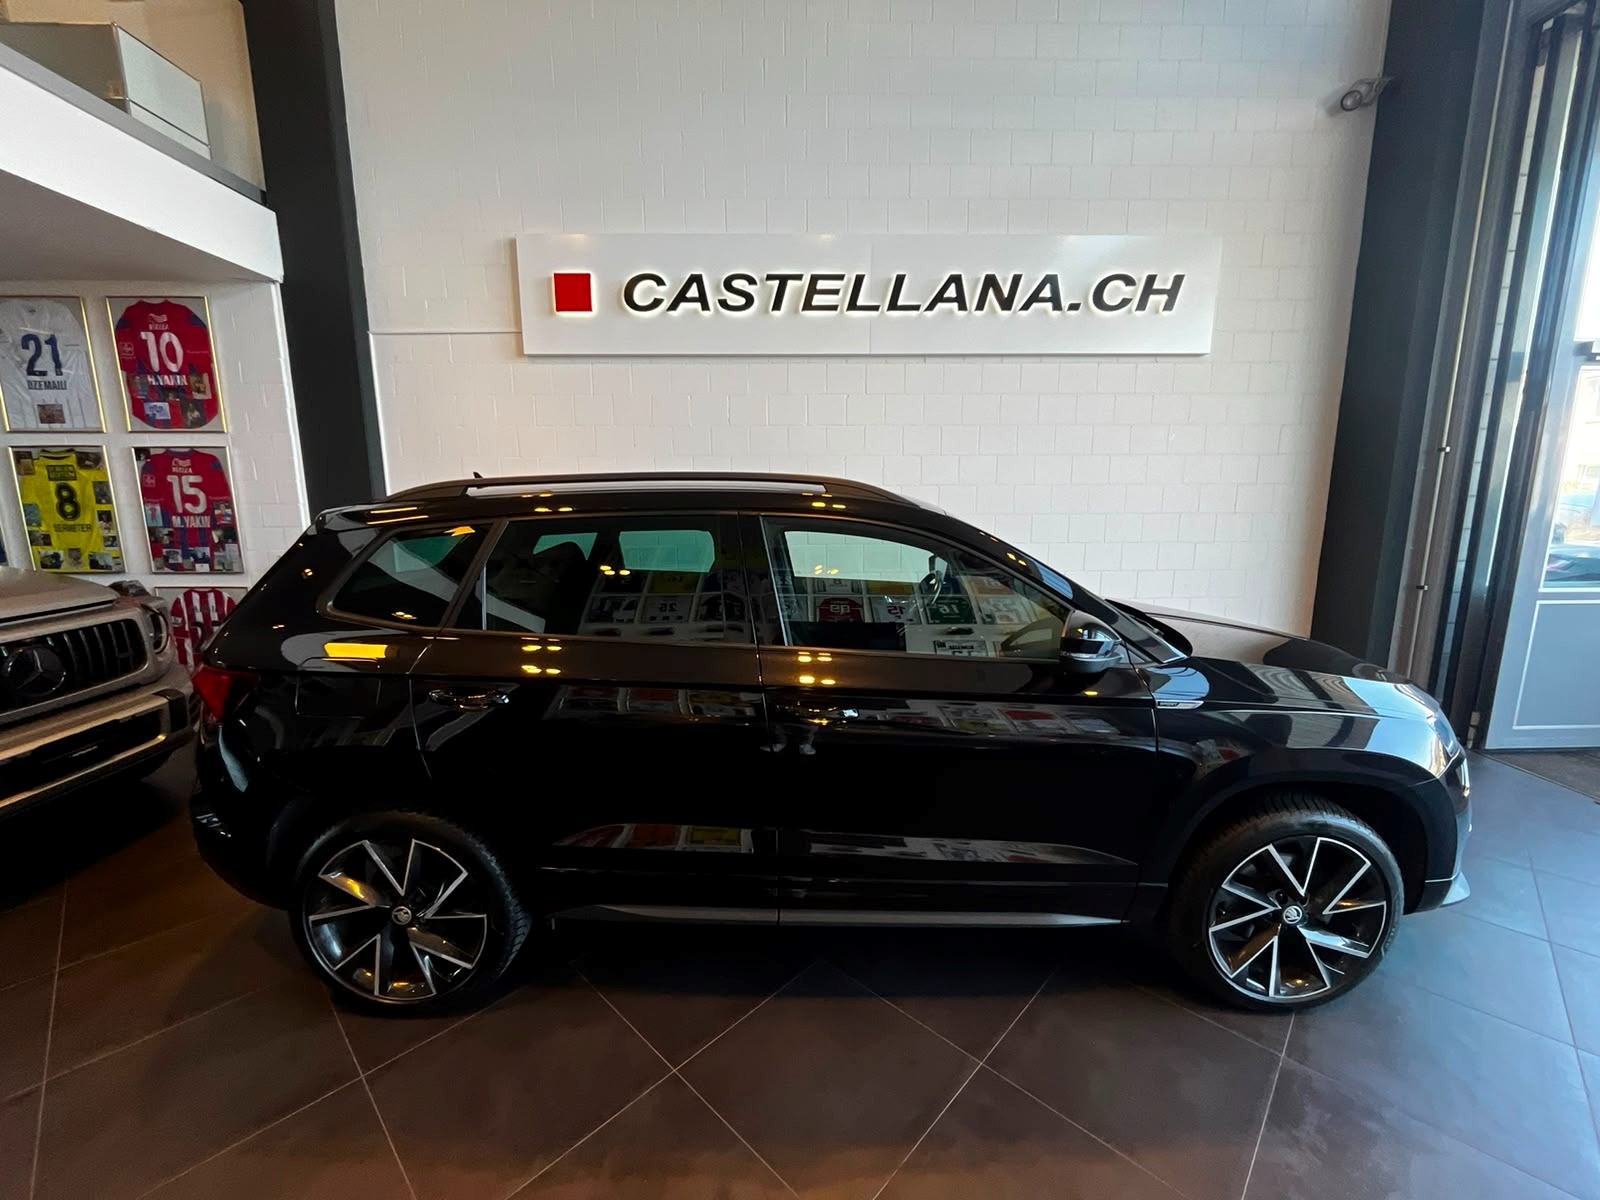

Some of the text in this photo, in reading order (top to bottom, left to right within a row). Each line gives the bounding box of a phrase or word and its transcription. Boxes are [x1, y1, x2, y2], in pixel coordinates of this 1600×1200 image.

[623, 272, 1186, 312] CASTELLANA.CH
[21, 333, 63, 376] 21
[140, 331, 184, 372] 10
[54, 482, 81, 521] 8
[166, 474, 207, 514] 15
